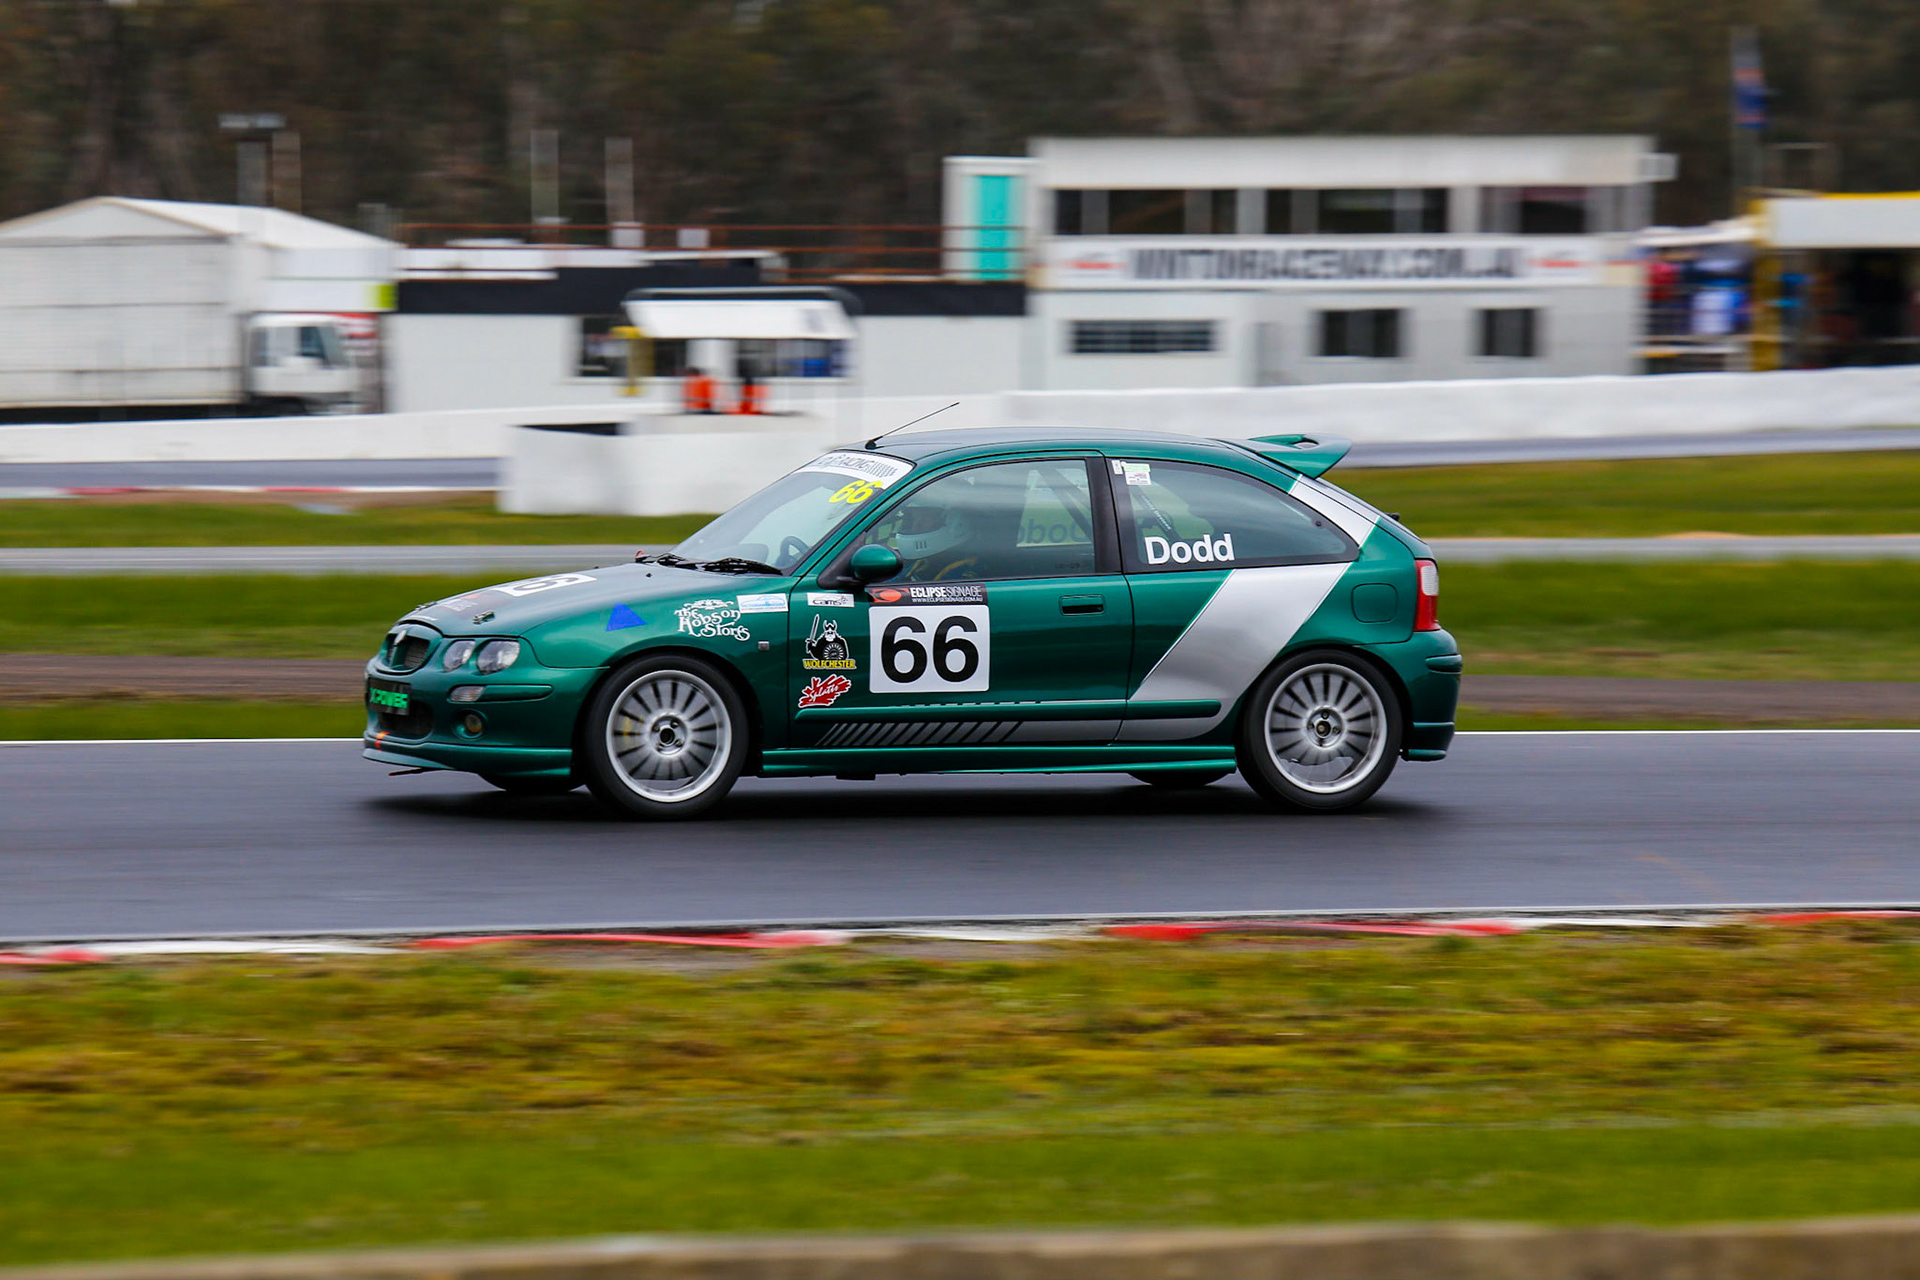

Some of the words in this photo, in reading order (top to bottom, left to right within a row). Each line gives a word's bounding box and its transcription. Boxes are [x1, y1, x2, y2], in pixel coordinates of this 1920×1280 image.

[829, 480, 883, 504] 66
[1144, 533, 1235, 564] Dodd
[881, 615, 979, 684] 66
